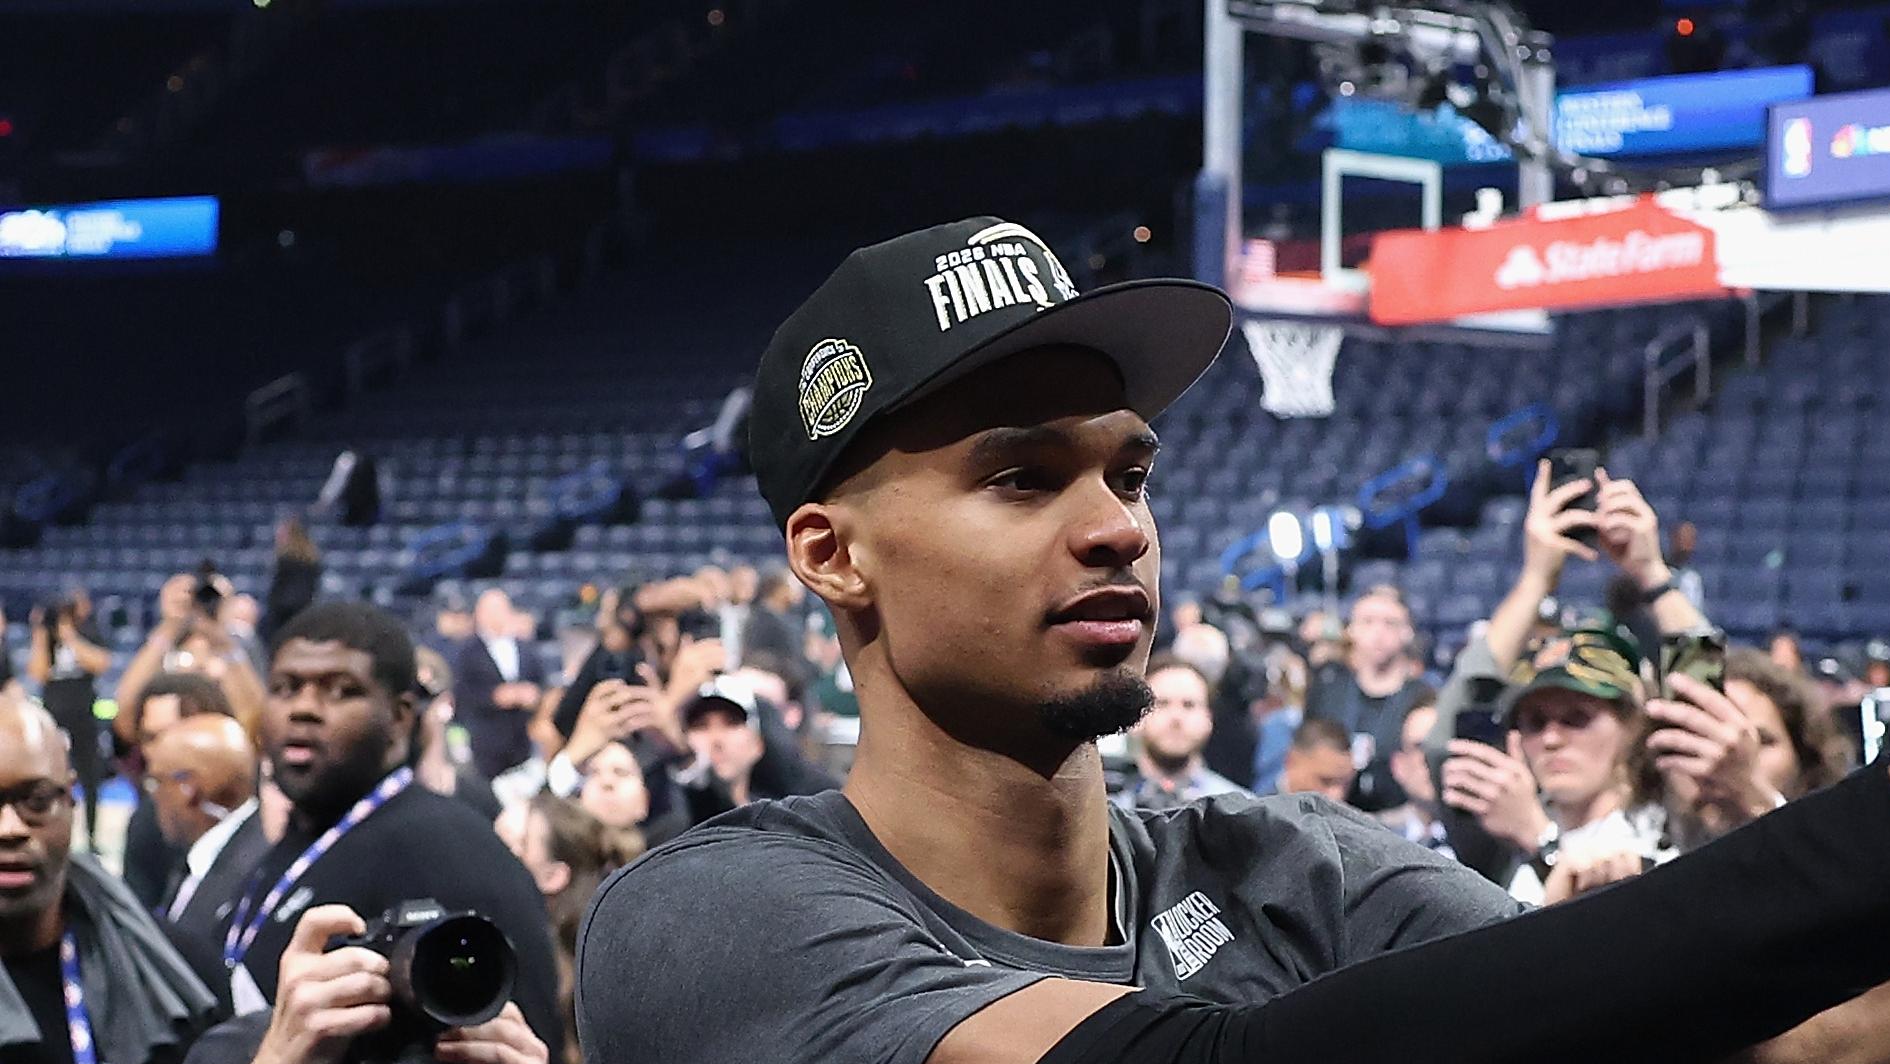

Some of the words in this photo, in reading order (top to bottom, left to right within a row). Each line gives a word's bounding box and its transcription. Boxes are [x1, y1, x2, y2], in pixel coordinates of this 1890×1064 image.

[990, 242, 1028, 257] NBA
[923, 256, 1051, 332] FINALS
[802, 355, 863, 426] CHAMPIONS
[1168, 890, 1222, 940] LOCKER
[1183, 916, 1236, 964] ROOM
